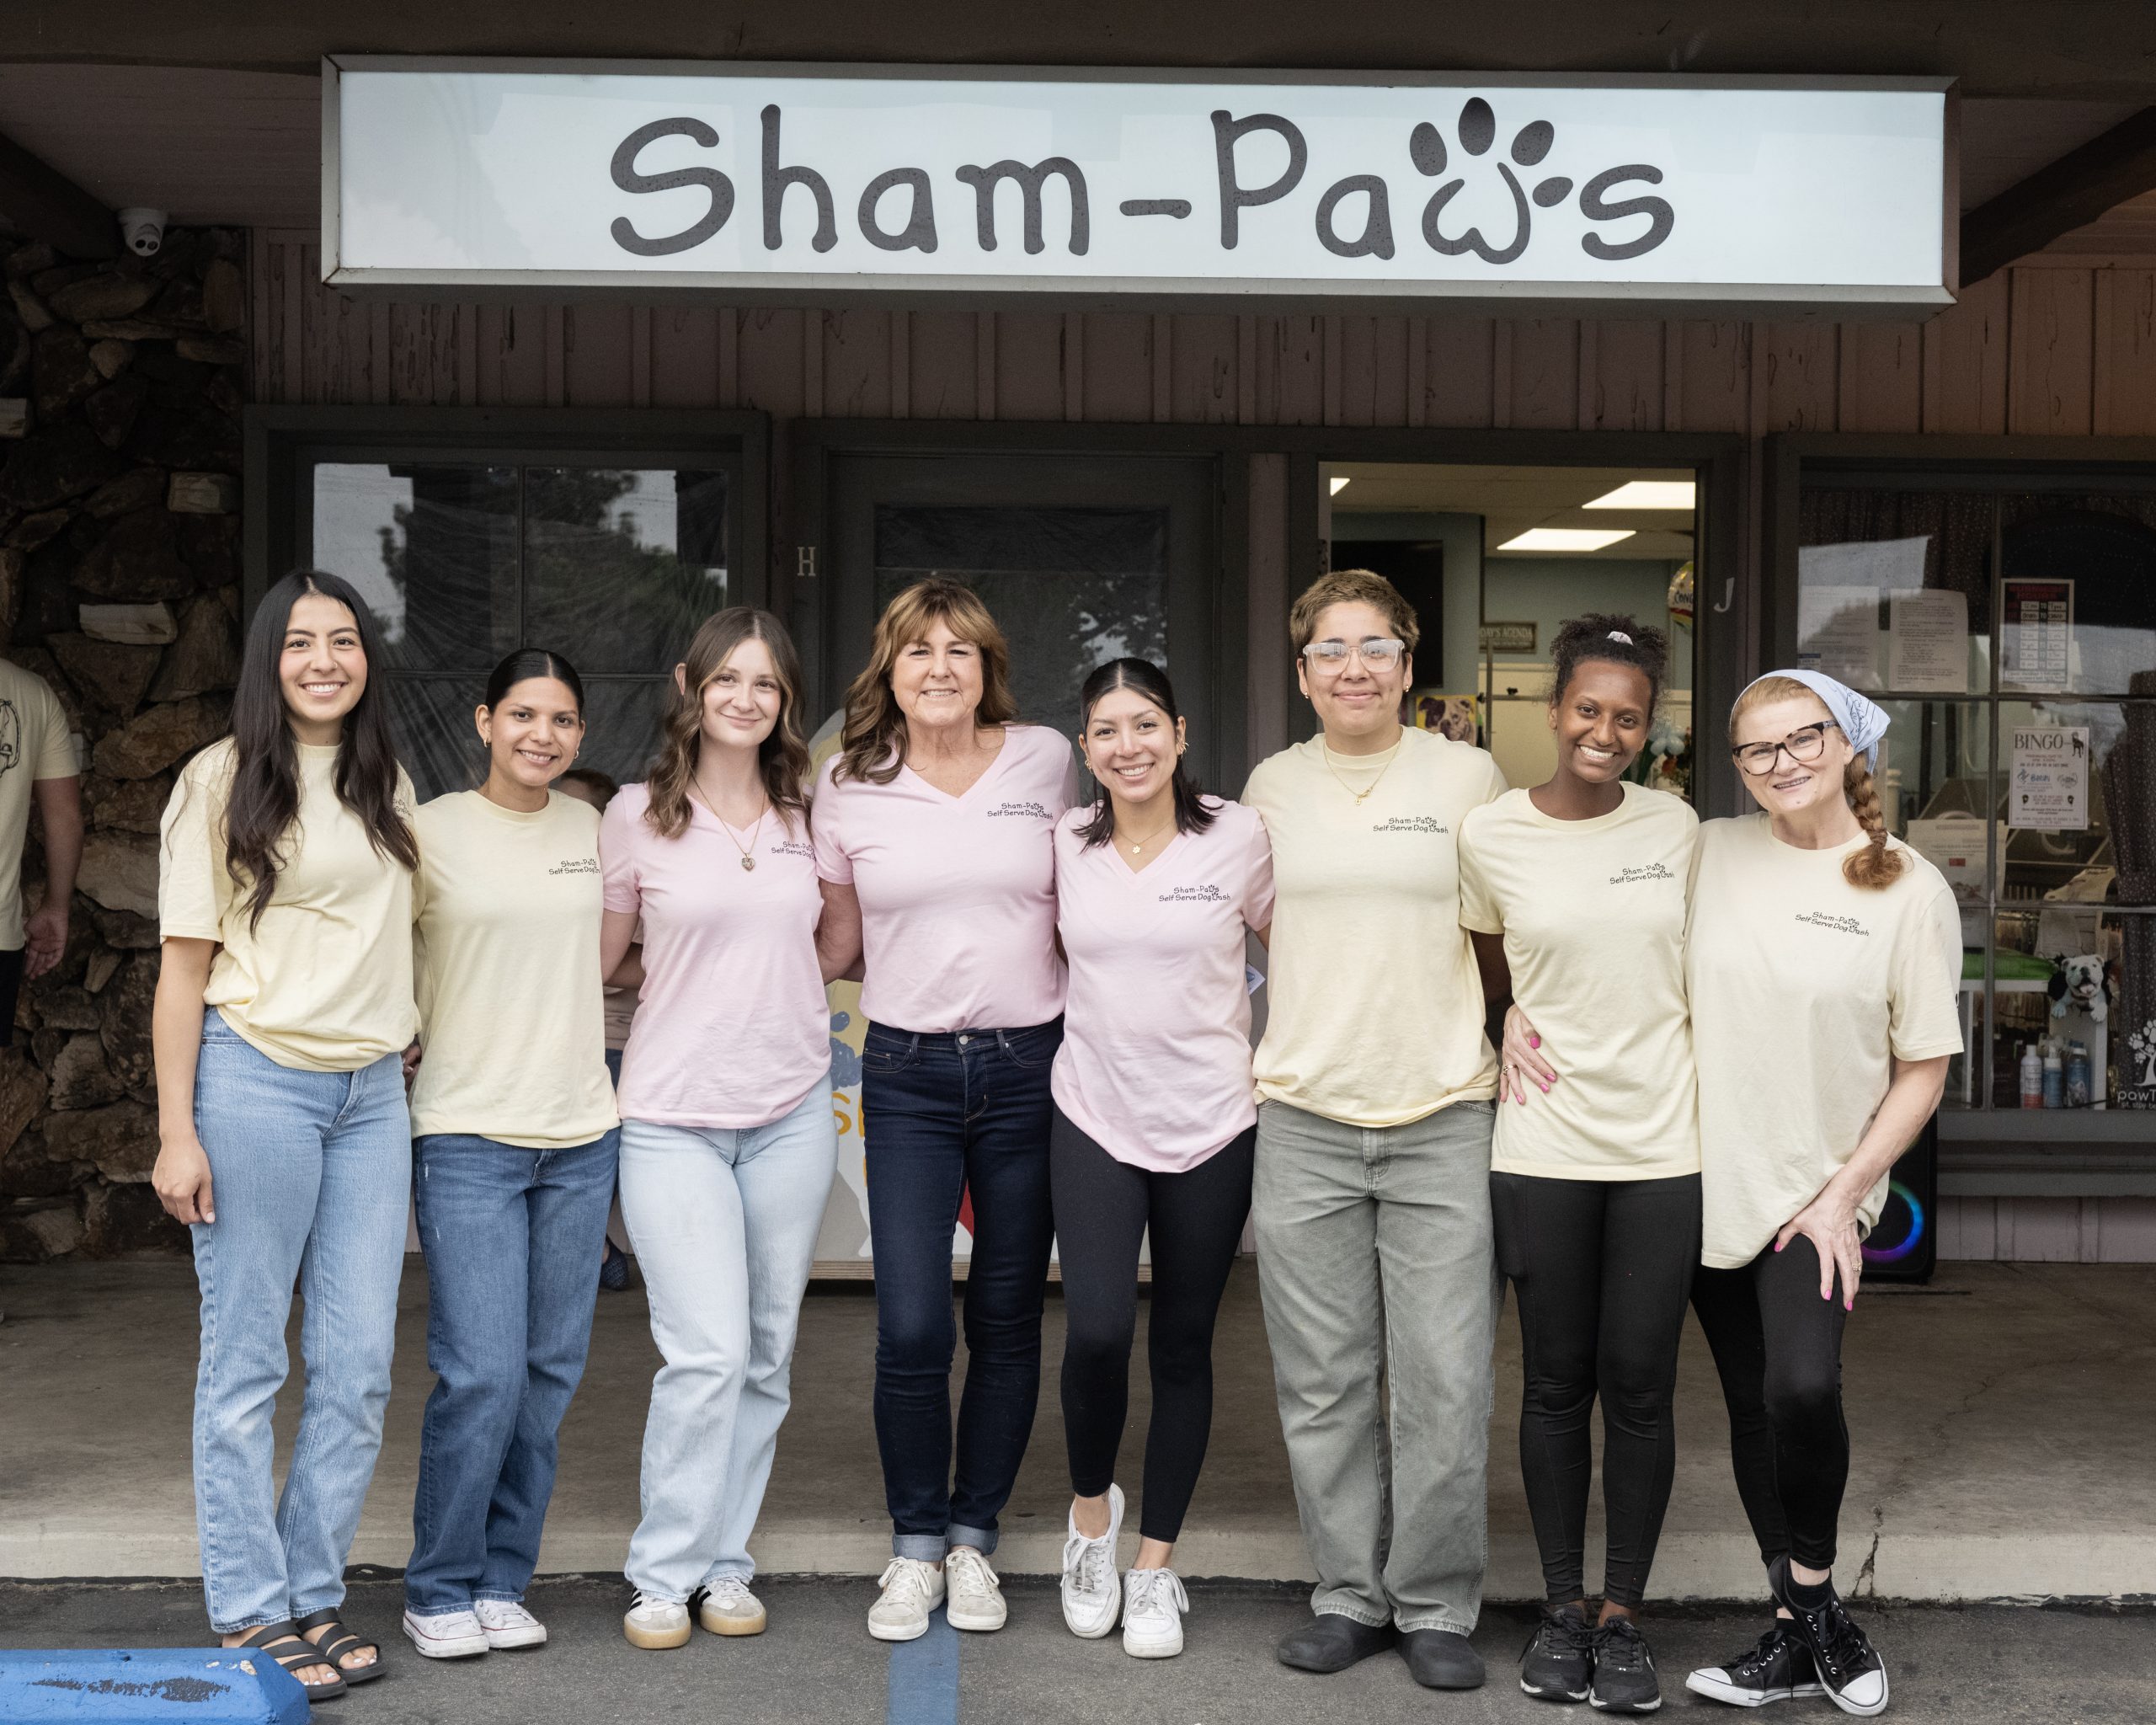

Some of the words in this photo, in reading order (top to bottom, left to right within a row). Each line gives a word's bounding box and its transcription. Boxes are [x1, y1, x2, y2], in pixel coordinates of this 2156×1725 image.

[610, 97, 1675, 264] Sham-Paws
[797, 546, 816, 577] H
[1713, 577, 1735, 612] J
[2015, 734, 2063, 750] BINGO
[1388, 816, 1438, 825] Sham-Paws
[1622, 862, 1666, 876] Sham-Paws
[1609, 876, 1625, 884] Self
[1625, 874, 1646, 883] Serve
[1173, 884, 1219, 894] Sham-Paws
[1795, 914, 1812, 922] Self
[1811, 918, 1833, 928] Serve
[1812, 911, 1860, 927] Sham-Paws
